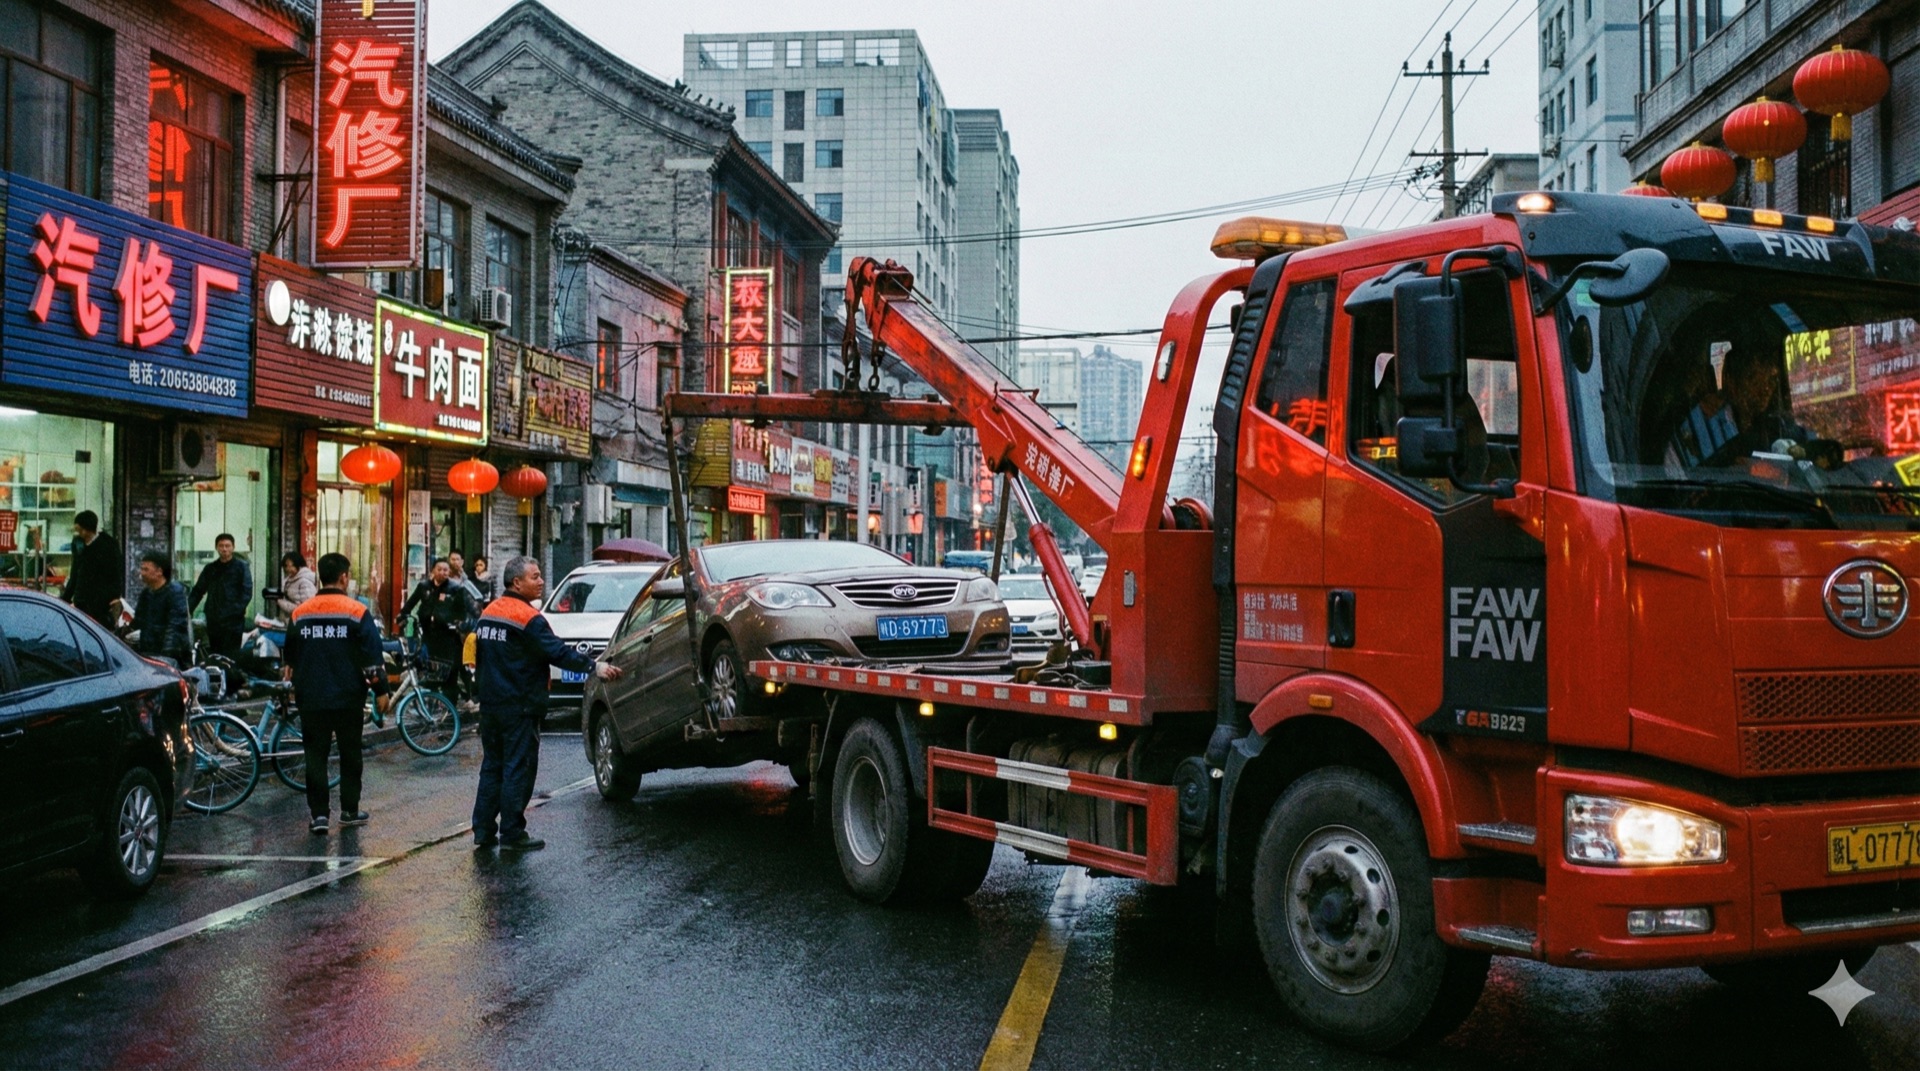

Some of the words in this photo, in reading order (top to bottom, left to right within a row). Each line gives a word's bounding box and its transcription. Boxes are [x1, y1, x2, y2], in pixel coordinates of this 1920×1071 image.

[326, 39, 407, 247] 汽修厂
[1756, 232, 1831, 262] FAW
[29, 212, 239, 355] 汽修厂
[394, 329, 482, 411] 牛肉面
[1450, 587, 1540, 618] FAW
[1450, 617, 1542, 662] FAW
